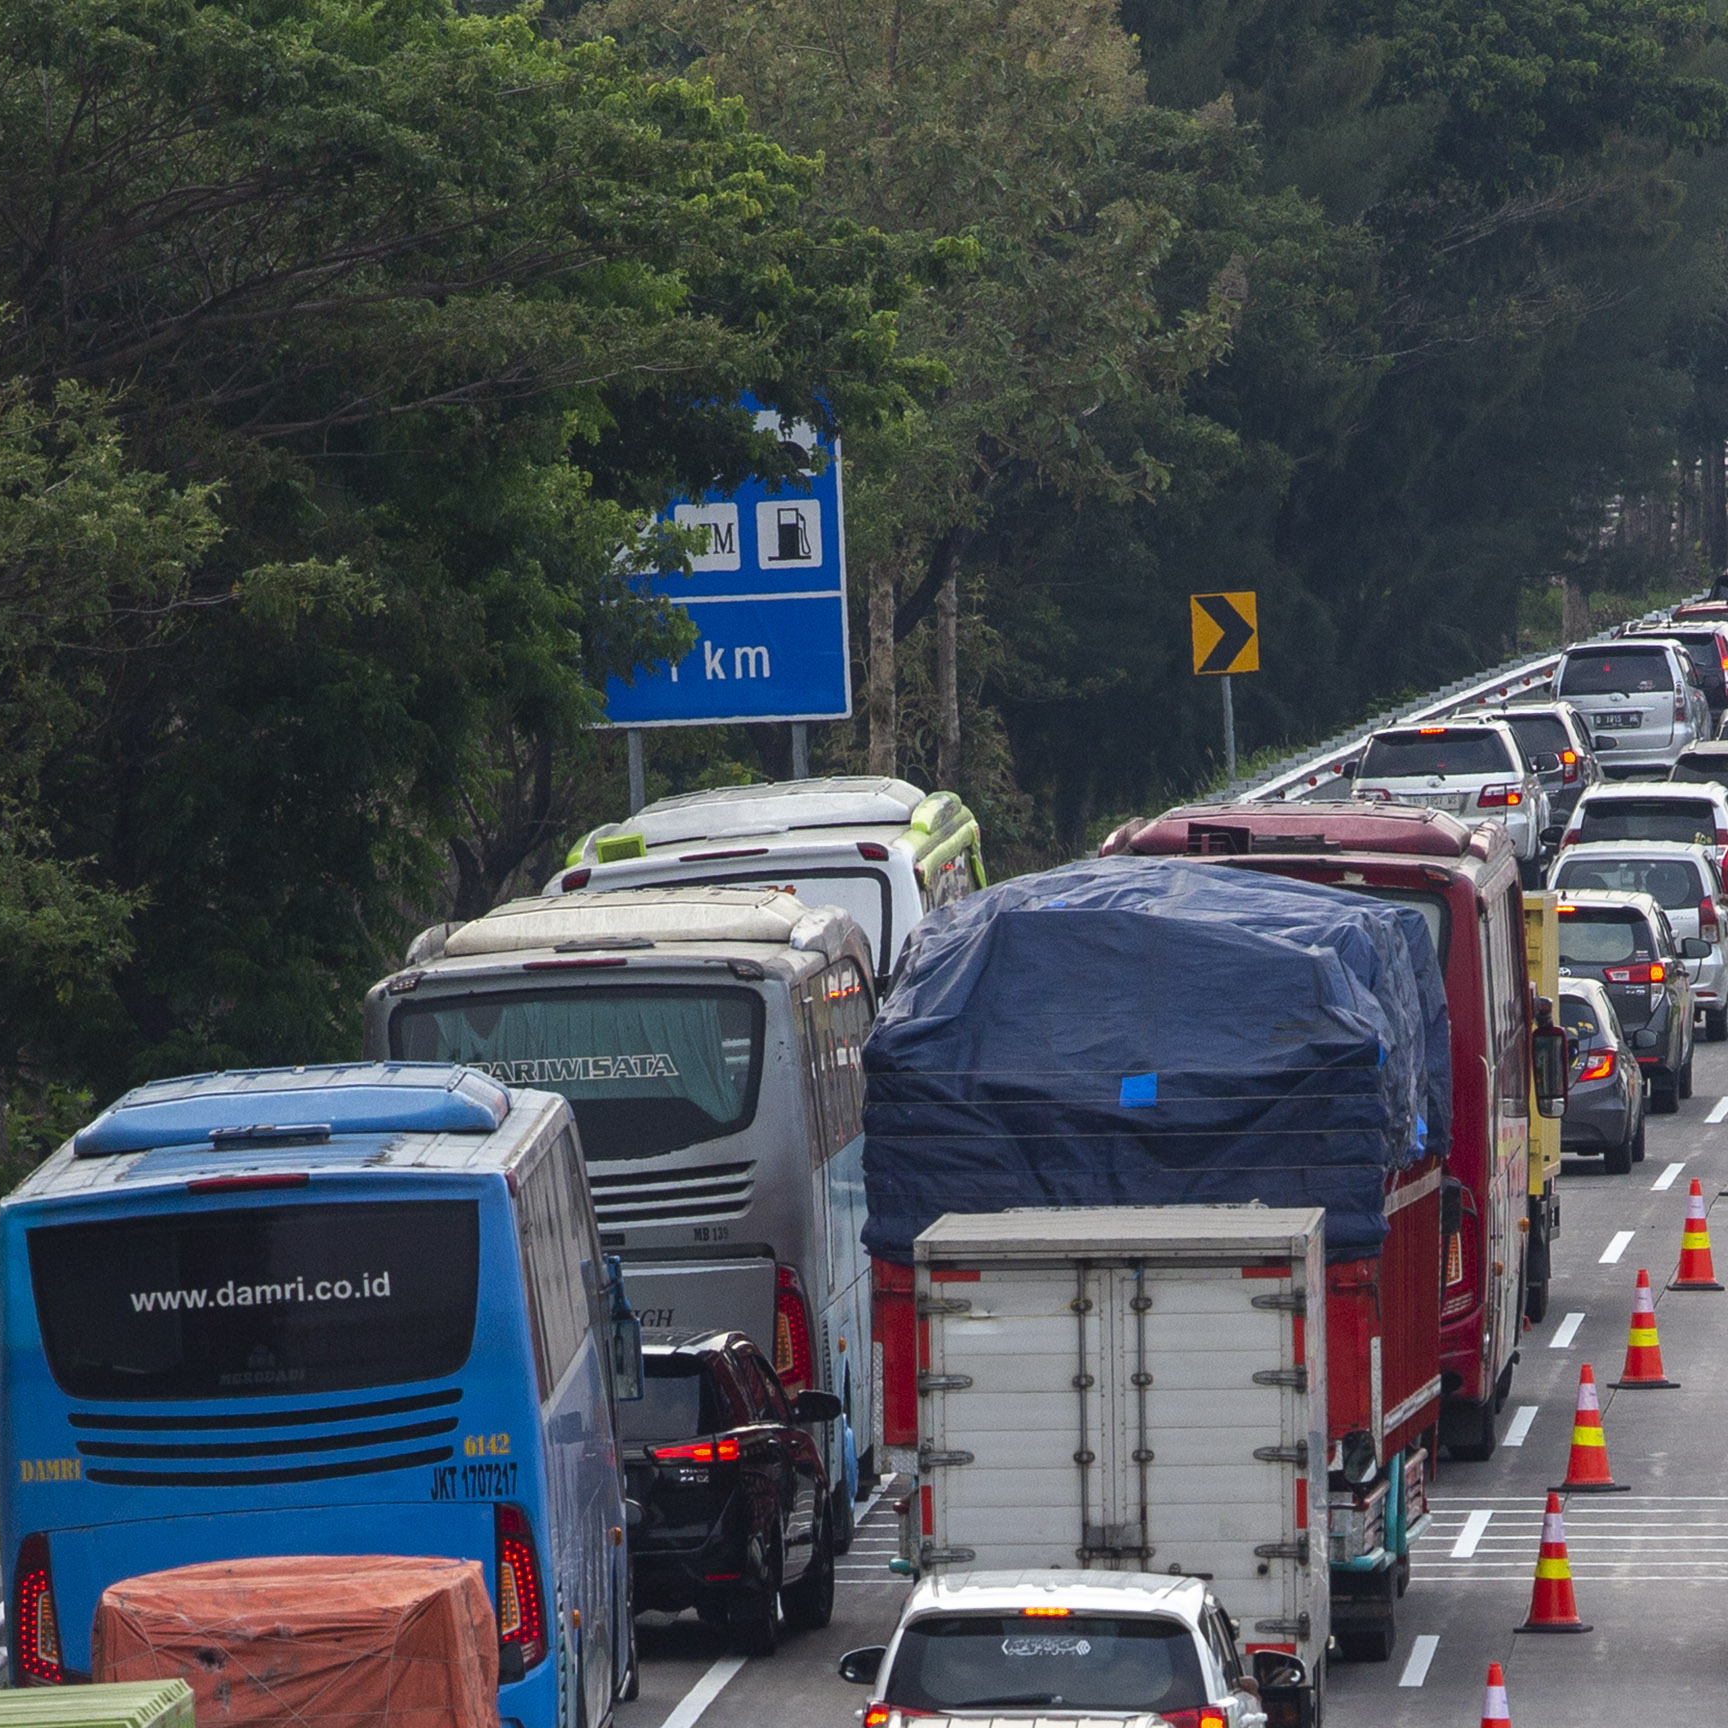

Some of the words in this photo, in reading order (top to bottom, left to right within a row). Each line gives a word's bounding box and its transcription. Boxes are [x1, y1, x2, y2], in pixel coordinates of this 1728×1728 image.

[704, 640, 771, 680] km
[694, 1226, 710, 1241] MB
[713, 1225, 729, 1240] 139
[130, 1270, 391, 1313] www.damri.co.id
[464, 1432, 511, 1458] 6142
[20, 1458, 81, 1482] DAMRI
[431, 1465, 457, 1500] JKT
[462, 1461, 518, 1498] 1707217
